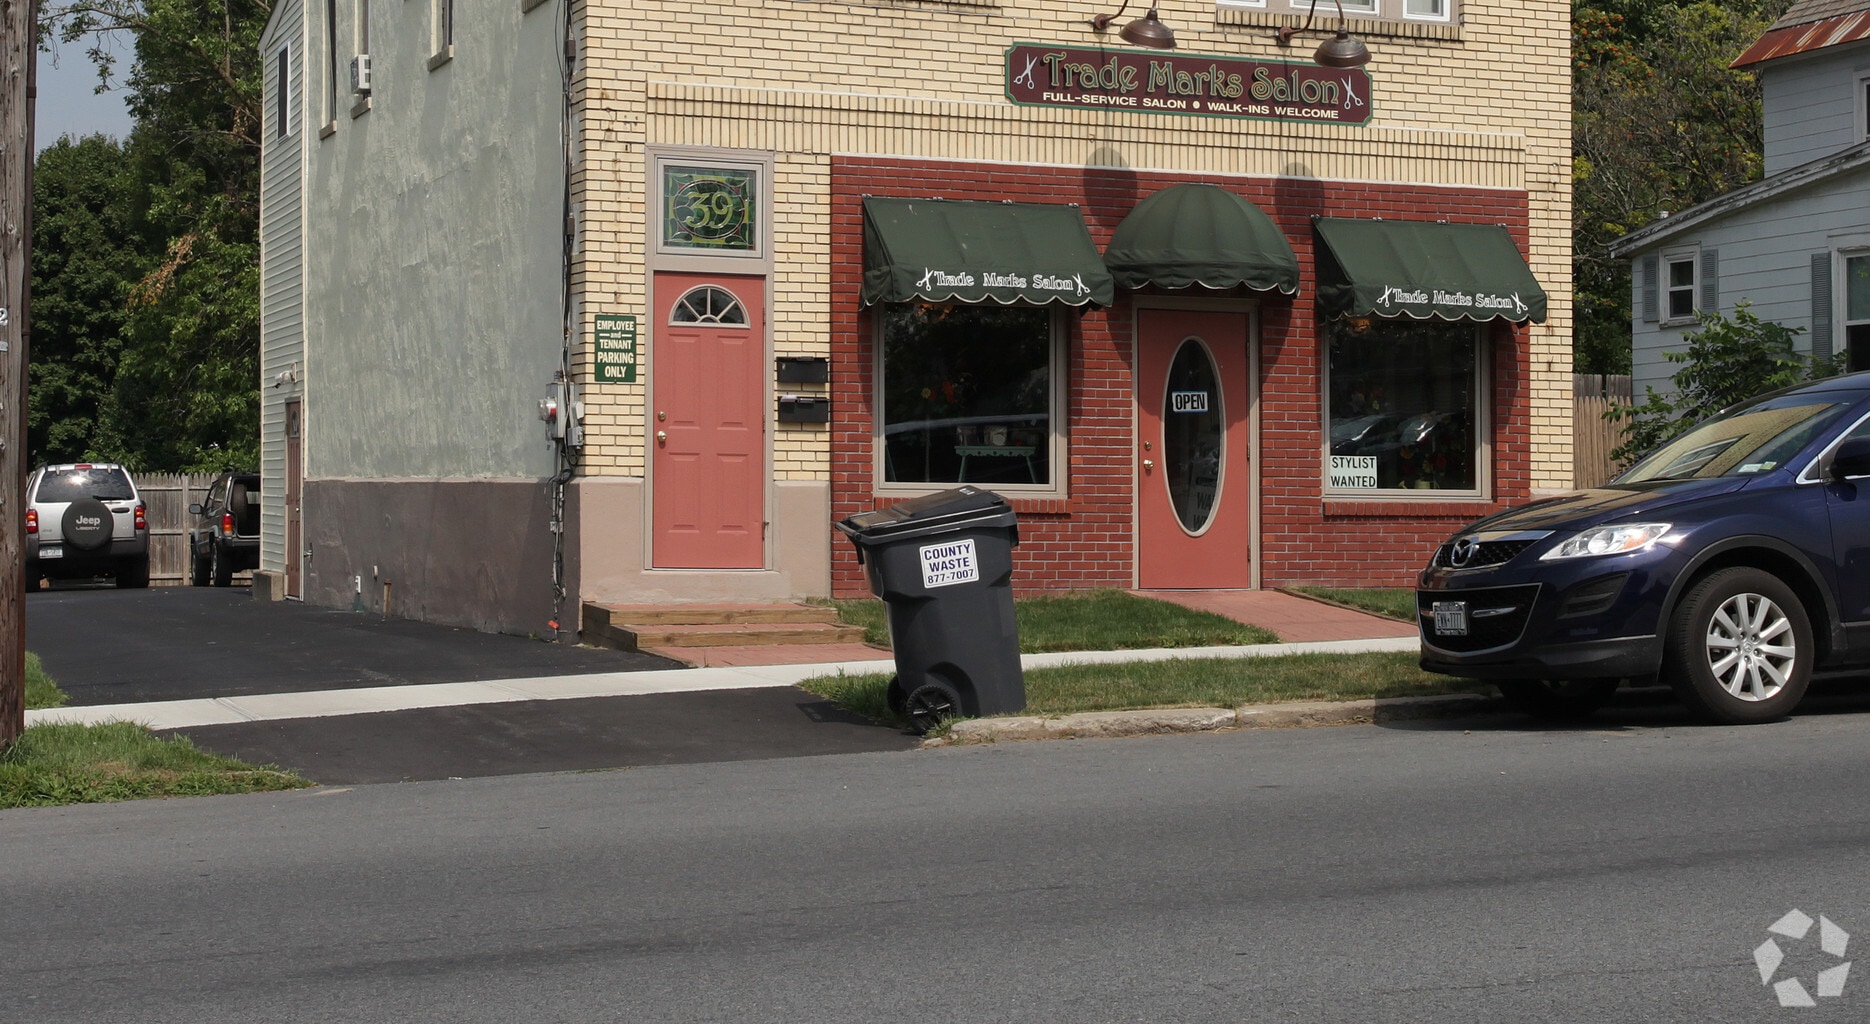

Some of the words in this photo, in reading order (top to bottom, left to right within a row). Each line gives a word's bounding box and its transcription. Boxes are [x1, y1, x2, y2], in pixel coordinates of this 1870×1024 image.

[1042, 51, 1138, 93] Trade
[1147, 61, 1243, 98] Marks
[1251, 67, 1340, 104] Salon
[1043, 92, 1137, 106] FULL-SERVICE
[1143, 98, 1186, 109] SALON
[1207, 101, 1269, 114] WALK-INS
[1274, 106, 1339, 118] WELCOME
[685, 191, 733, 229] 39
[933, 270, 975, 287] Trade
[983, 272, 1027, 288] Marks
[1032, 274, 1073, 290] Salon
[1392, 288, 1428, 304] Trade
[1432, 290, 1472, 306] Marks
[1475, 293, 1513, 308] Salon
[596, 320, 634, 331] EMPLOYEE
[599, 339, 632, 349] TENNANT
[597, 352, 634, 364] PARKING
[604, 366, 627, 377] ONLY
[1175, 394, 1205, 410] OPEN
[1332, 456, 1375, 469] STYLIST
[1331, 476, 1376, 487] WANTED
[75, 515, 101, 526] Jeep
[924, 543, 970, 560] COUNTY
[929, 557, 970, 572] WASTE
[928, 569, 974, 584] 877-7007
